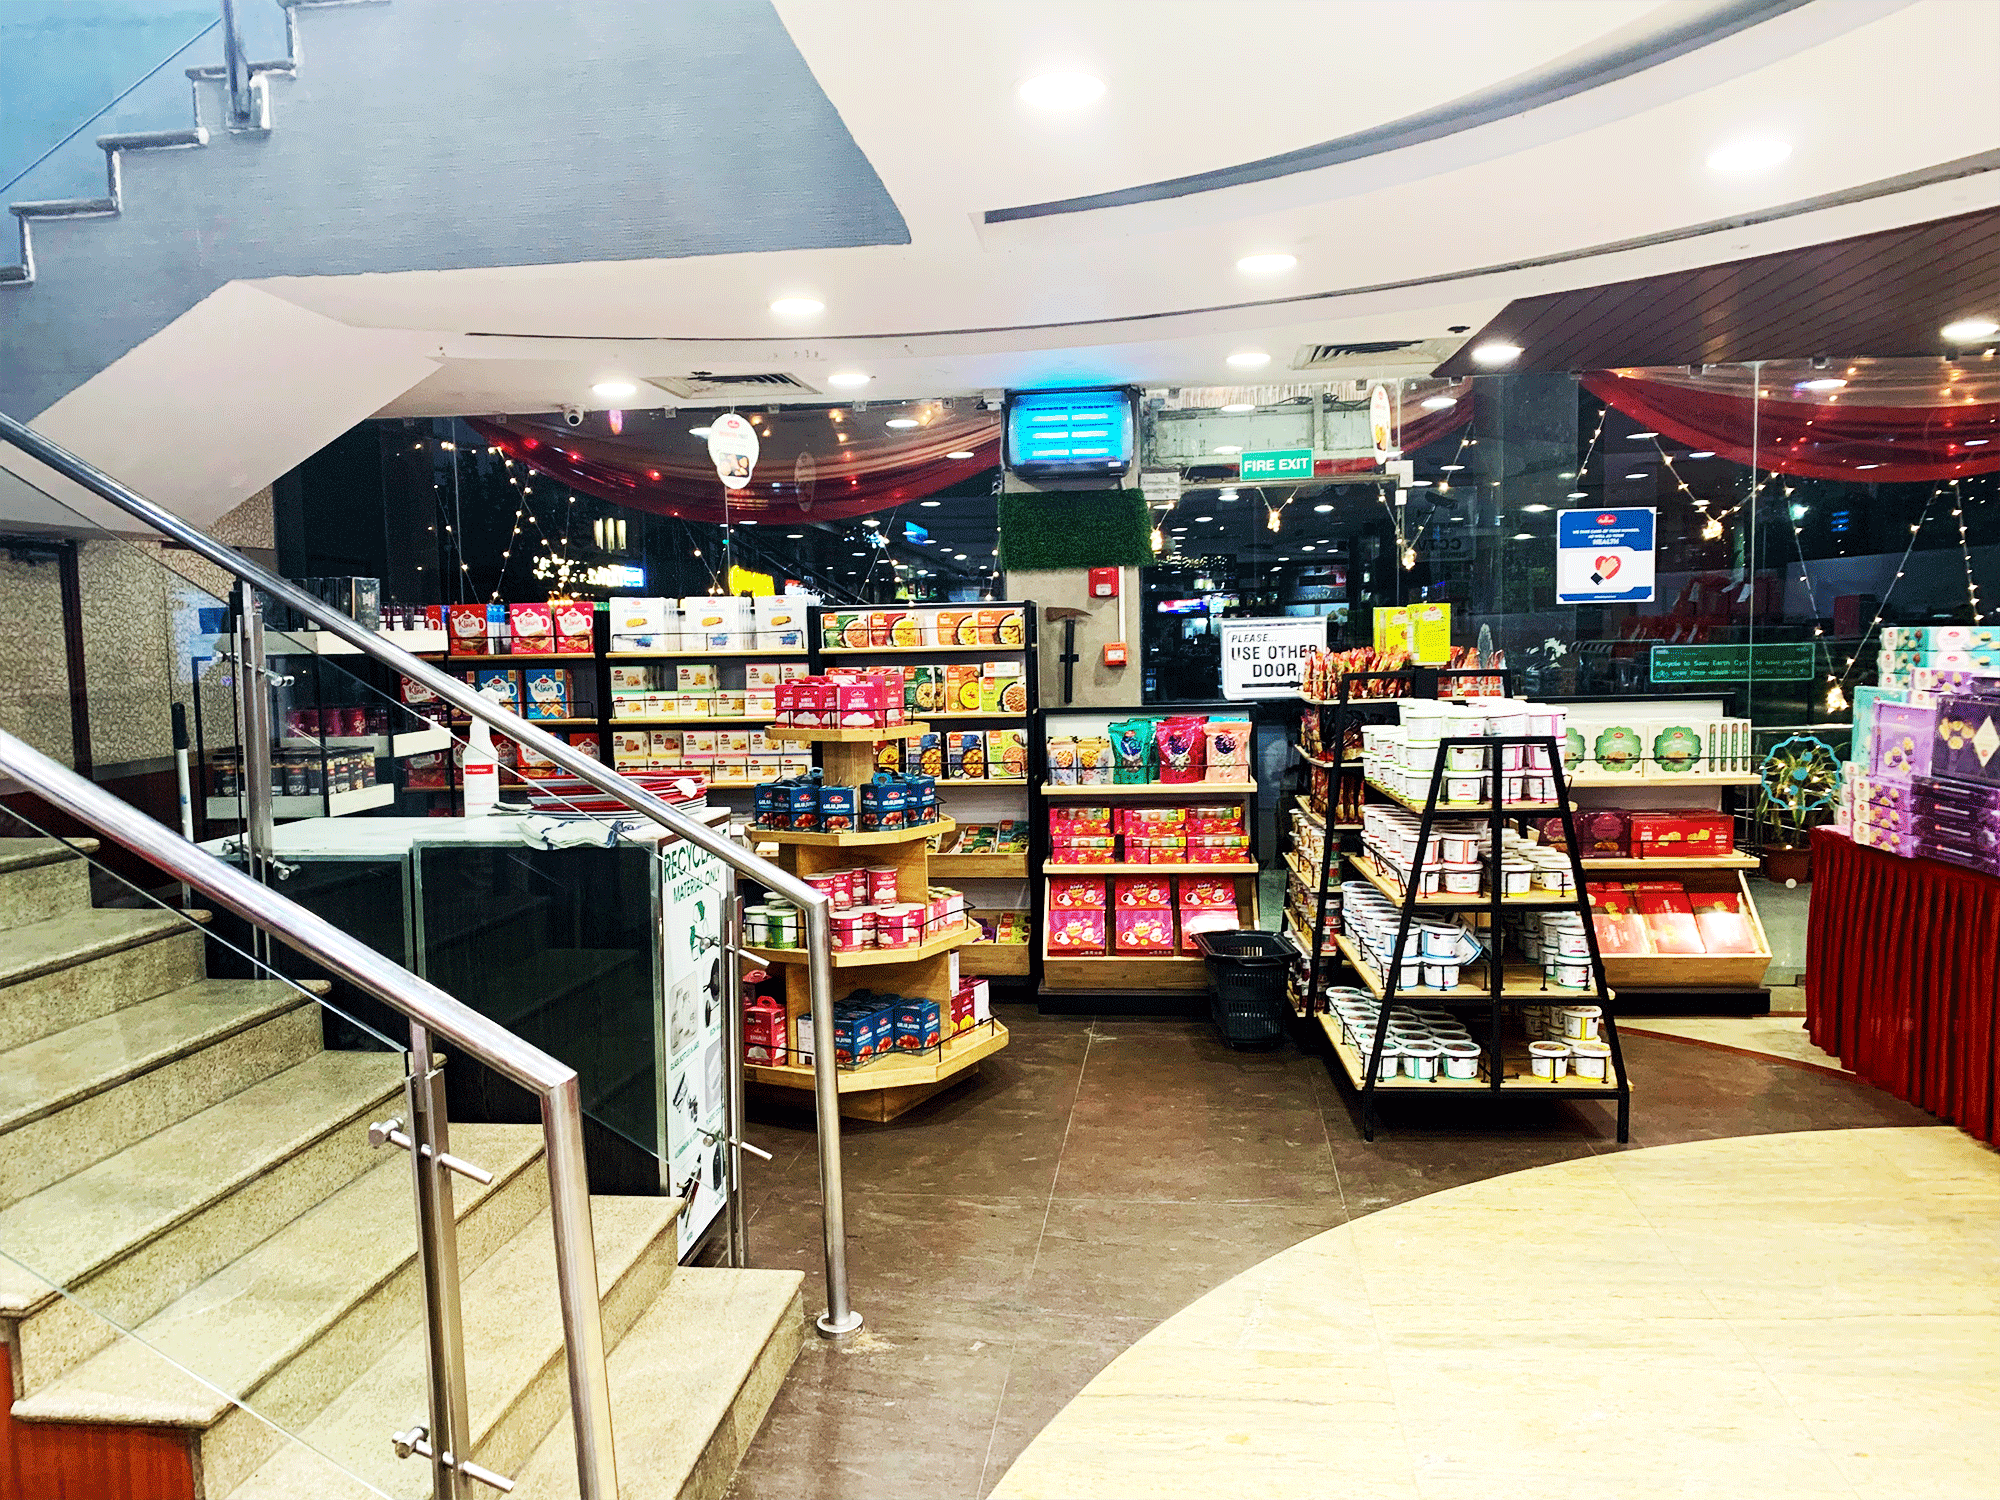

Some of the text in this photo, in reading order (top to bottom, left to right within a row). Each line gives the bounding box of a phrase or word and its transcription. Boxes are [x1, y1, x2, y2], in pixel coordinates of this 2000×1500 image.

[1244, 457, 1310, 473] FIRE EXIT
[1592, 537, 1620, 546] HEALTH
[1231, 644, 1318, 661] USE OTHER
[1252, 662, 1297, 678] DOOR
[1711, 658, 1731, 666] Earth
[673, 865, 721, 904] MATERIAL ONLY
